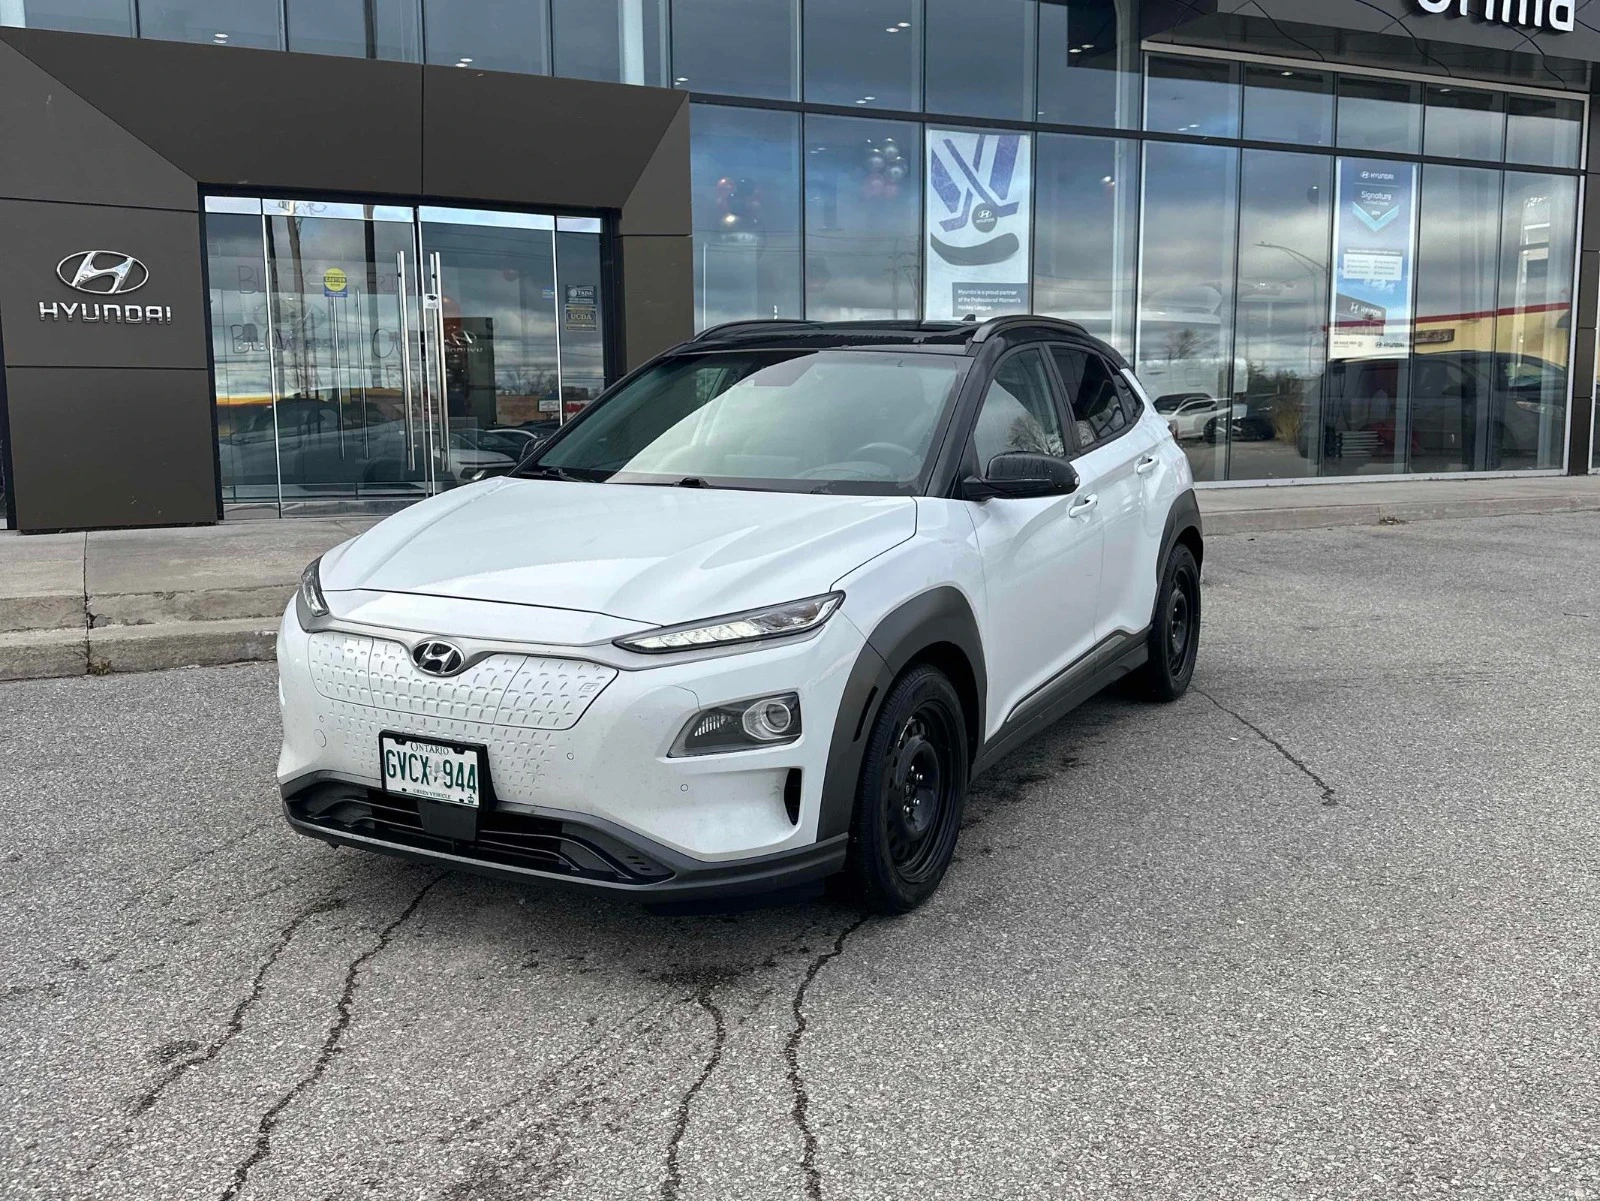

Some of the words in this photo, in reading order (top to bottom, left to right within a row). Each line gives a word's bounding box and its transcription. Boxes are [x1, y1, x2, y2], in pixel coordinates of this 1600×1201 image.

[1361, 190, 1392, 201] Signature
[39, 301, 171, 324] HYUNDAI
[410, 742, 449, 756] ONTARIO
[385, 749, 430, 785] GVCX
[443, 759, 477, 794] 944
[413, 788, 429, 796] GREEN
[430, 791, 452, 799] VEHICLE
